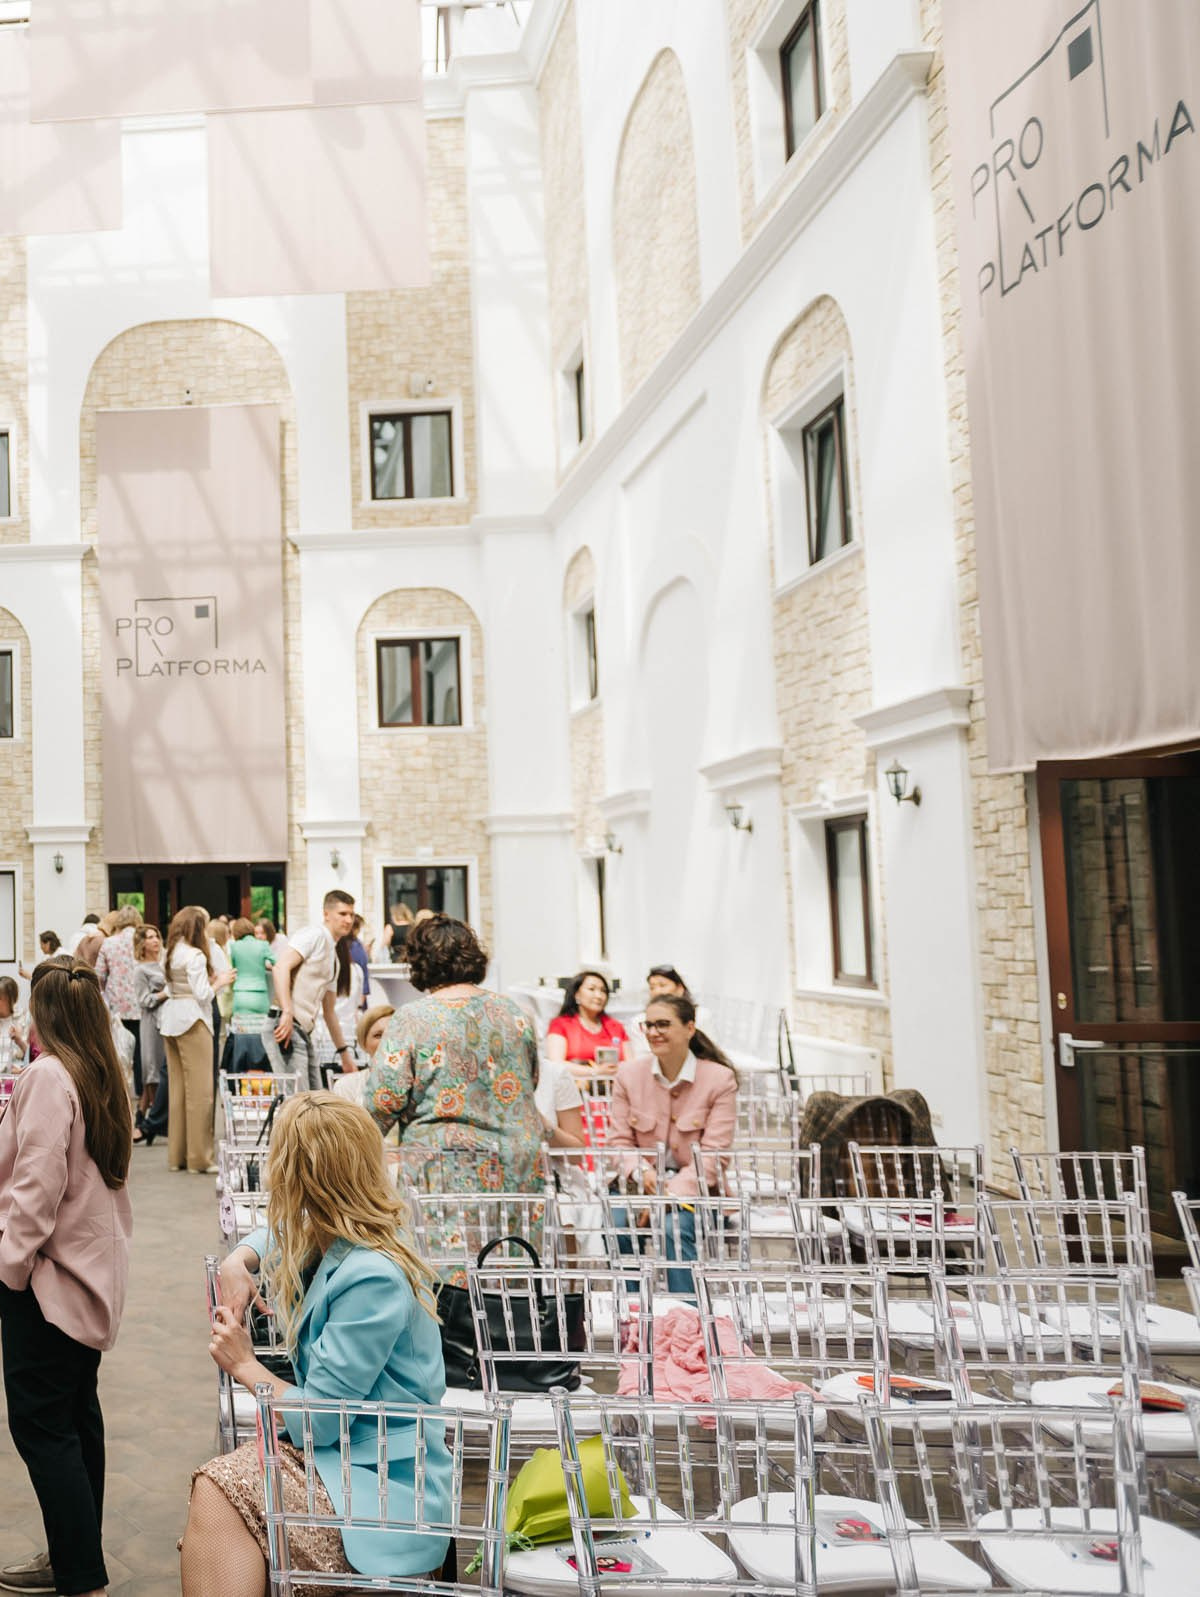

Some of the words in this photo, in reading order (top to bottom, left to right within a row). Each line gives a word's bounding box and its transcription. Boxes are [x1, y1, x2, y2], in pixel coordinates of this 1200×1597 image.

[971, 117, 1044, 220] PRO
[978, 100, 1196, 318] PLATFORMA
[116, 616, 174, 637] PRO
[116, 658, 267, 677] PLATFORMA
